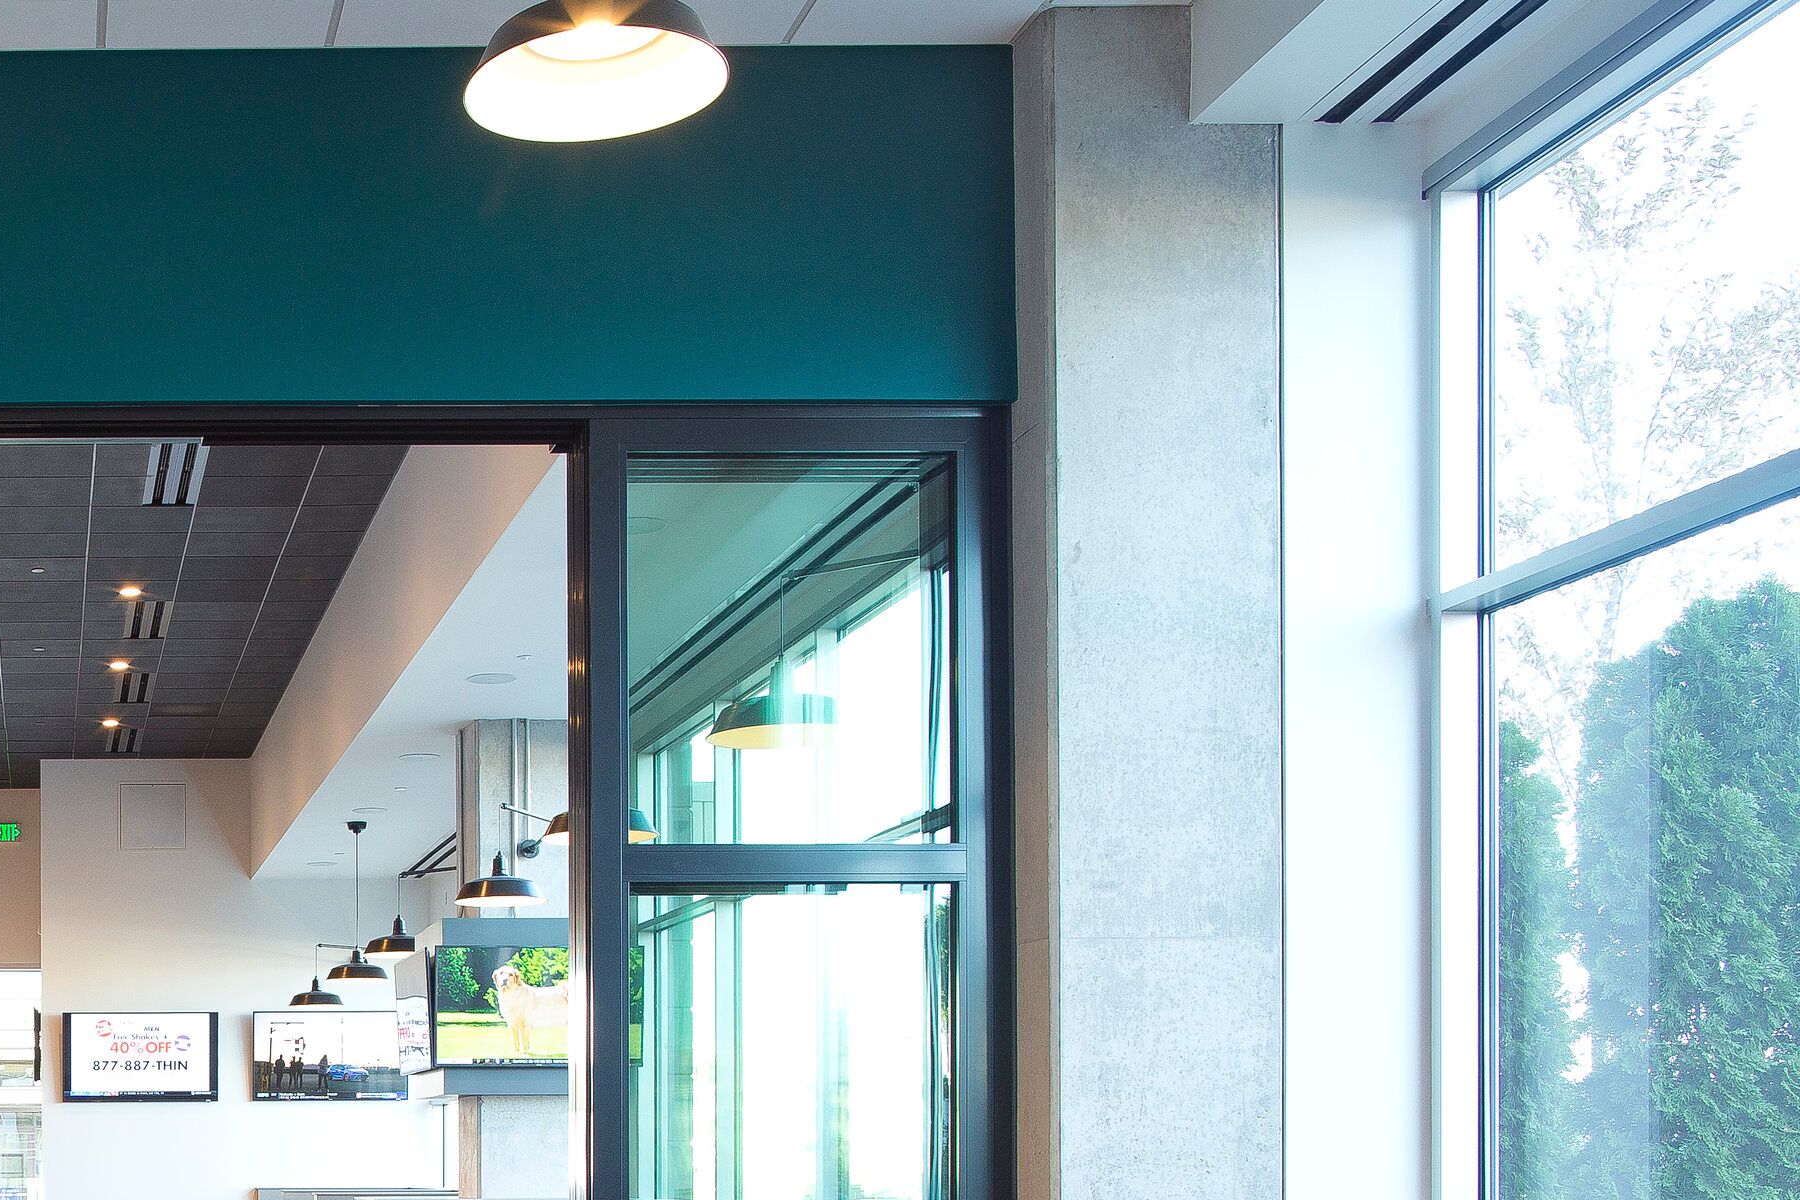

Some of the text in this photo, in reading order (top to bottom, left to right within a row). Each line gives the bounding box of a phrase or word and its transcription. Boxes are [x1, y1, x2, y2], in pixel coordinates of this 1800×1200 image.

[110, 1041, 144, 1053] 40%
[145, 1041, 172, 1053] OFF
[92, 1060, 188, 1071] 877-887-THIN
